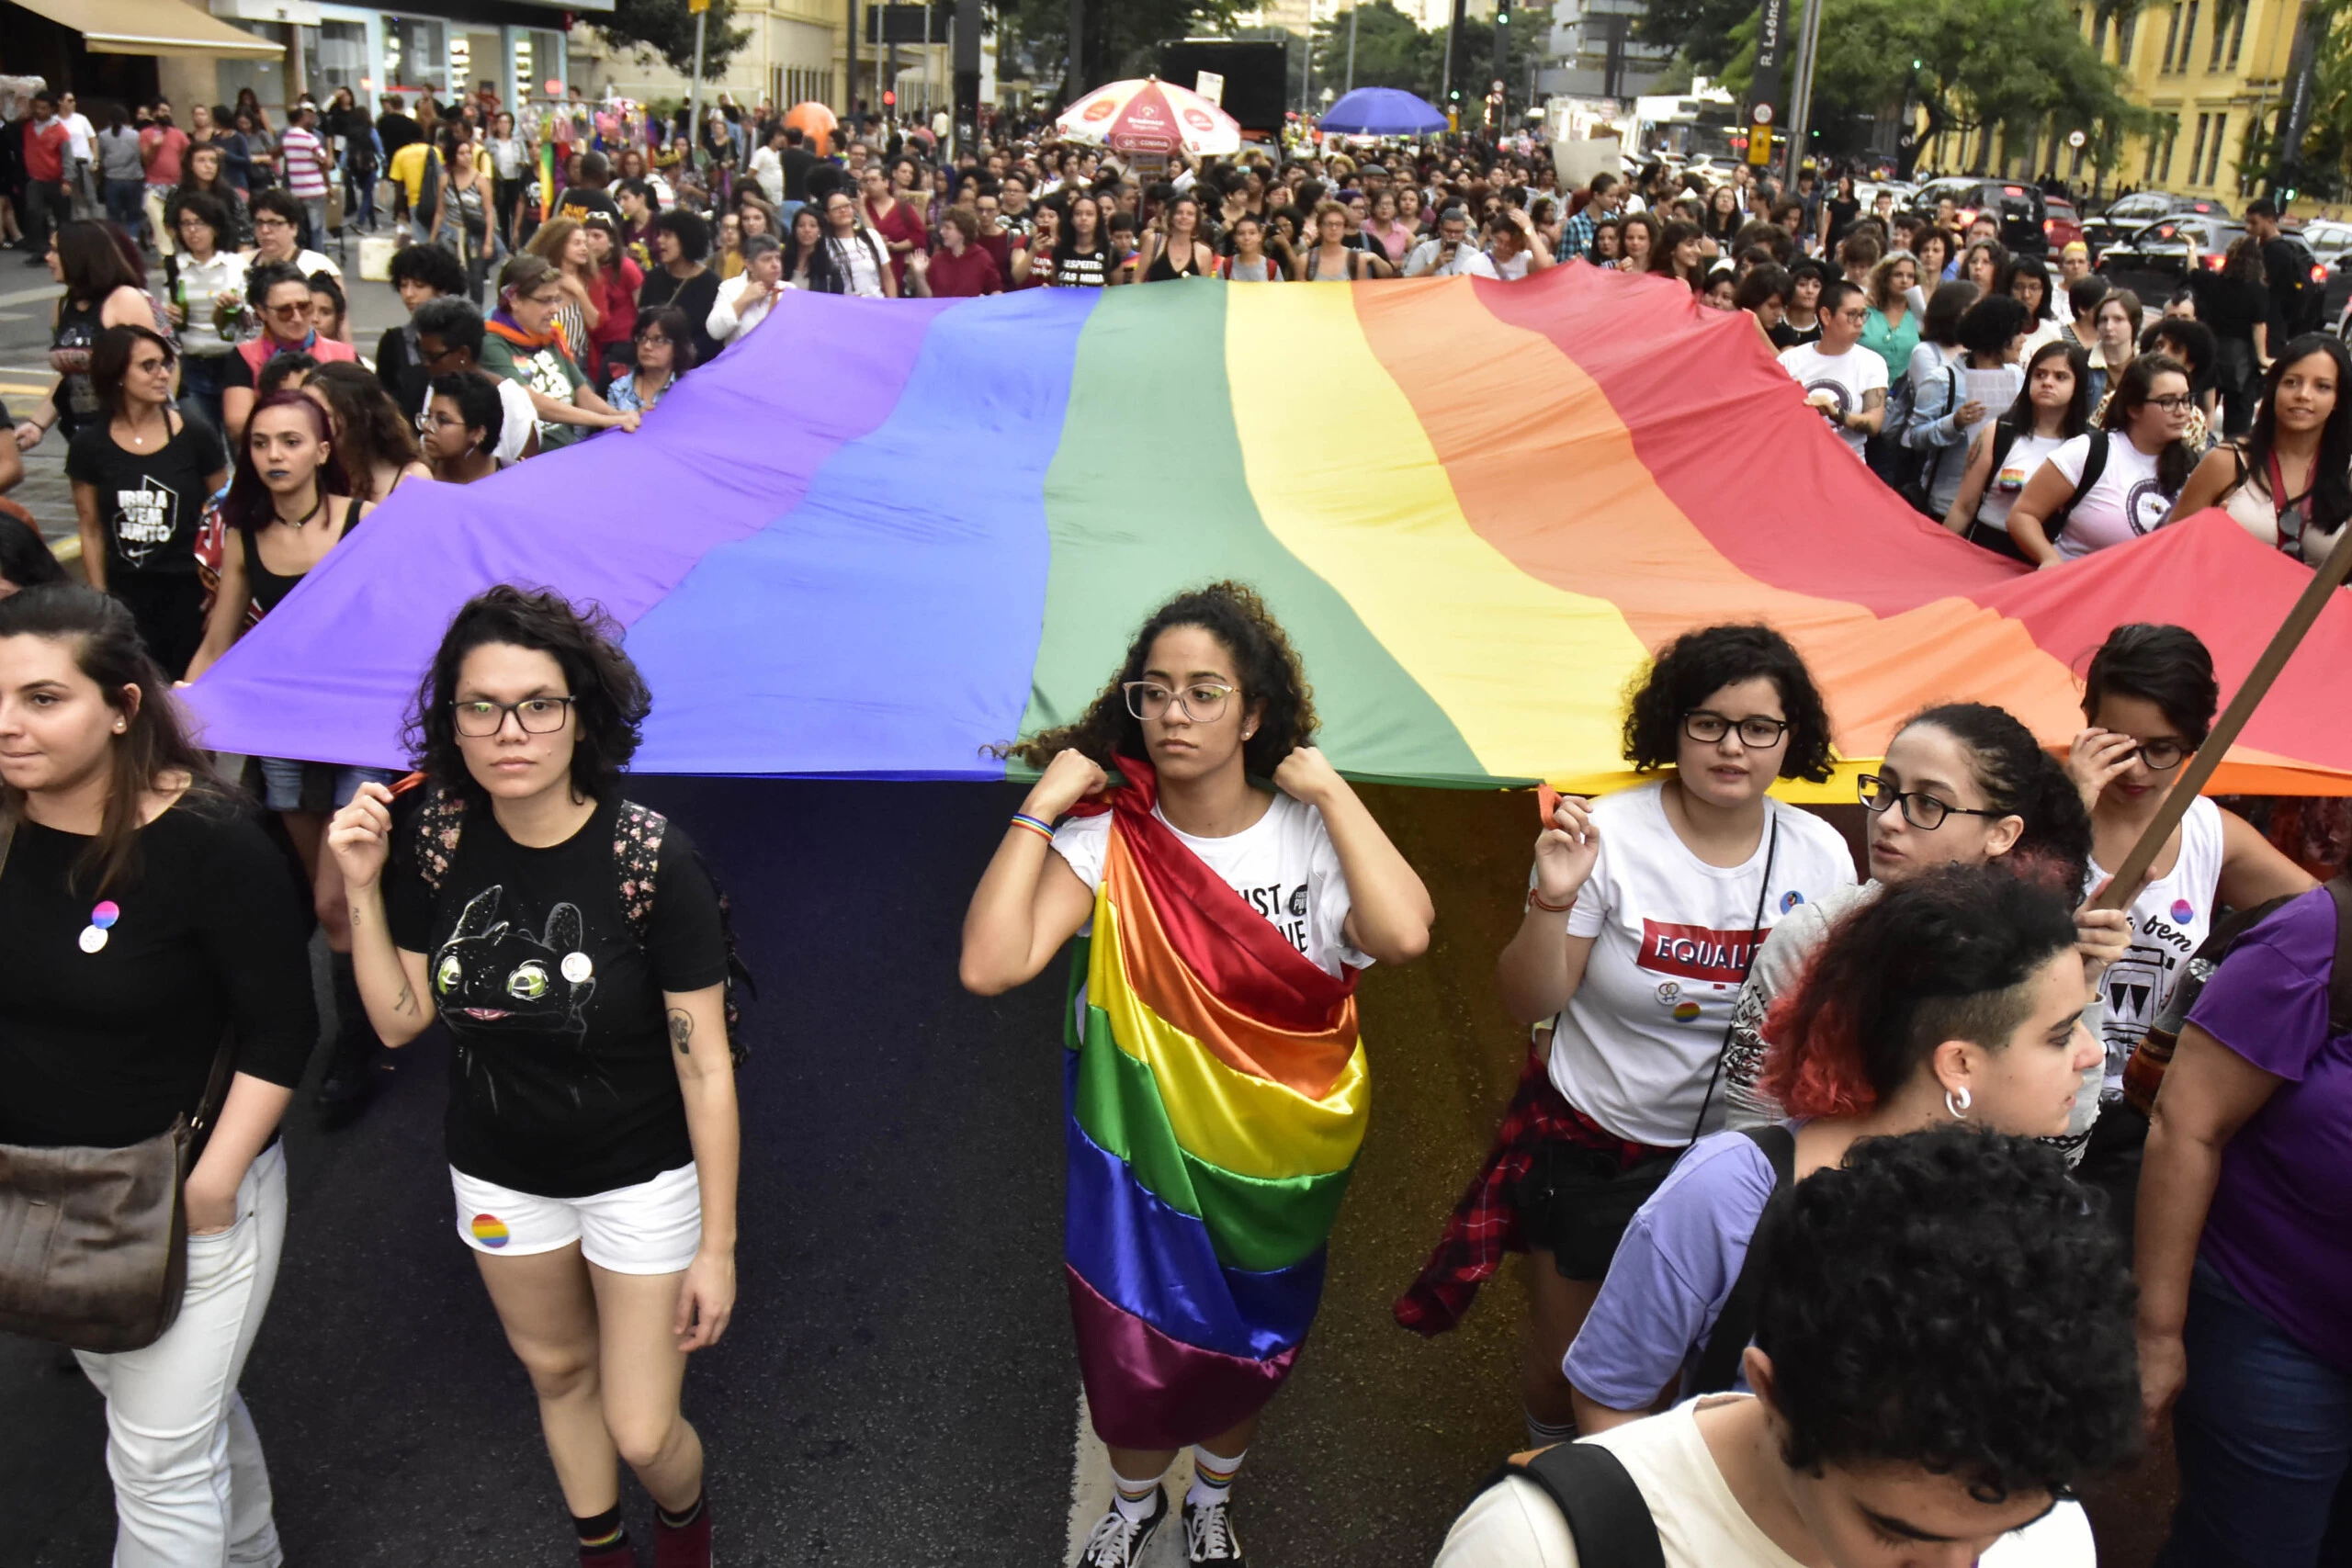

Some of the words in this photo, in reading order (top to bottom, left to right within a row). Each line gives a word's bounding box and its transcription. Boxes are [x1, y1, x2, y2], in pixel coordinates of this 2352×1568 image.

[1759, 52, 1773, 67] R.
[117, 490, 169, 509] IBIRA
[122, 506, 164, 526] VEM
[119, 521, 171, 544] JUNTO
